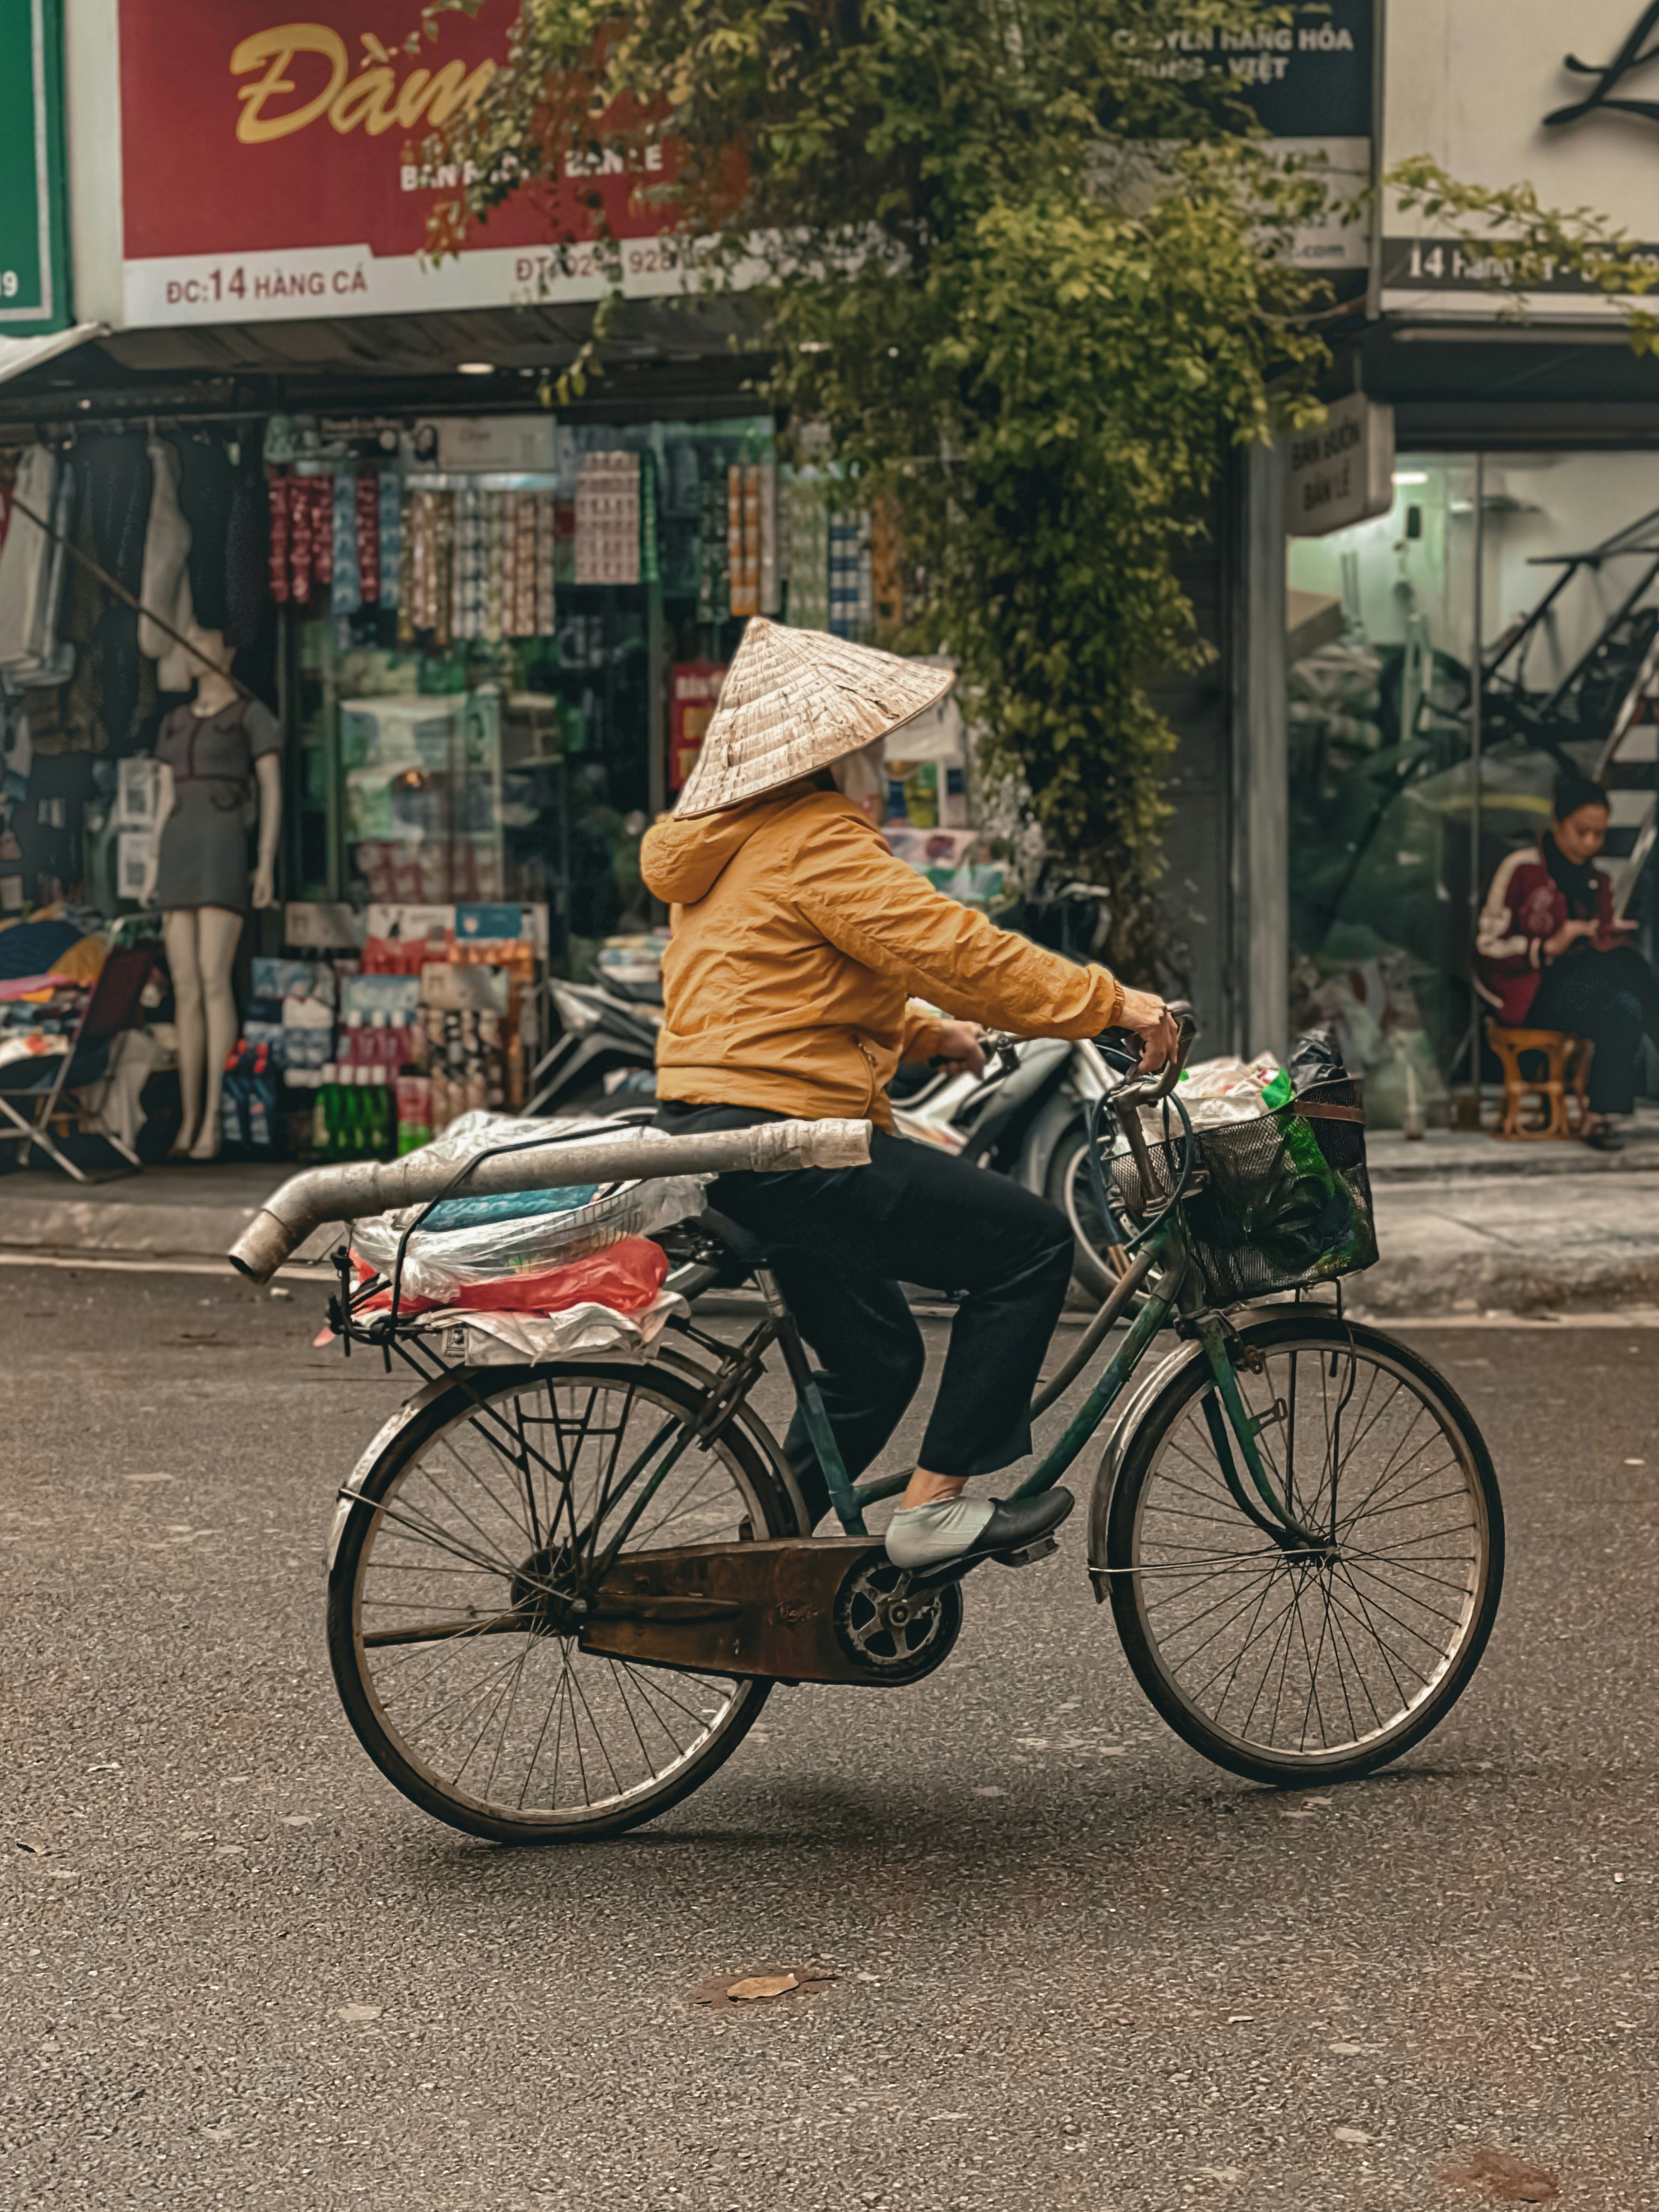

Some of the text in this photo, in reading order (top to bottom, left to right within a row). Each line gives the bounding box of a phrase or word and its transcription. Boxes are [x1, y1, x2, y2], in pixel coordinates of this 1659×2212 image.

[1297, 22, 1354, 52] HÓA
[1410, 246, 1444, 279] 14
[254, 267, 326, 298] HÀNG
[332, 262, 367, 294] CÁ
